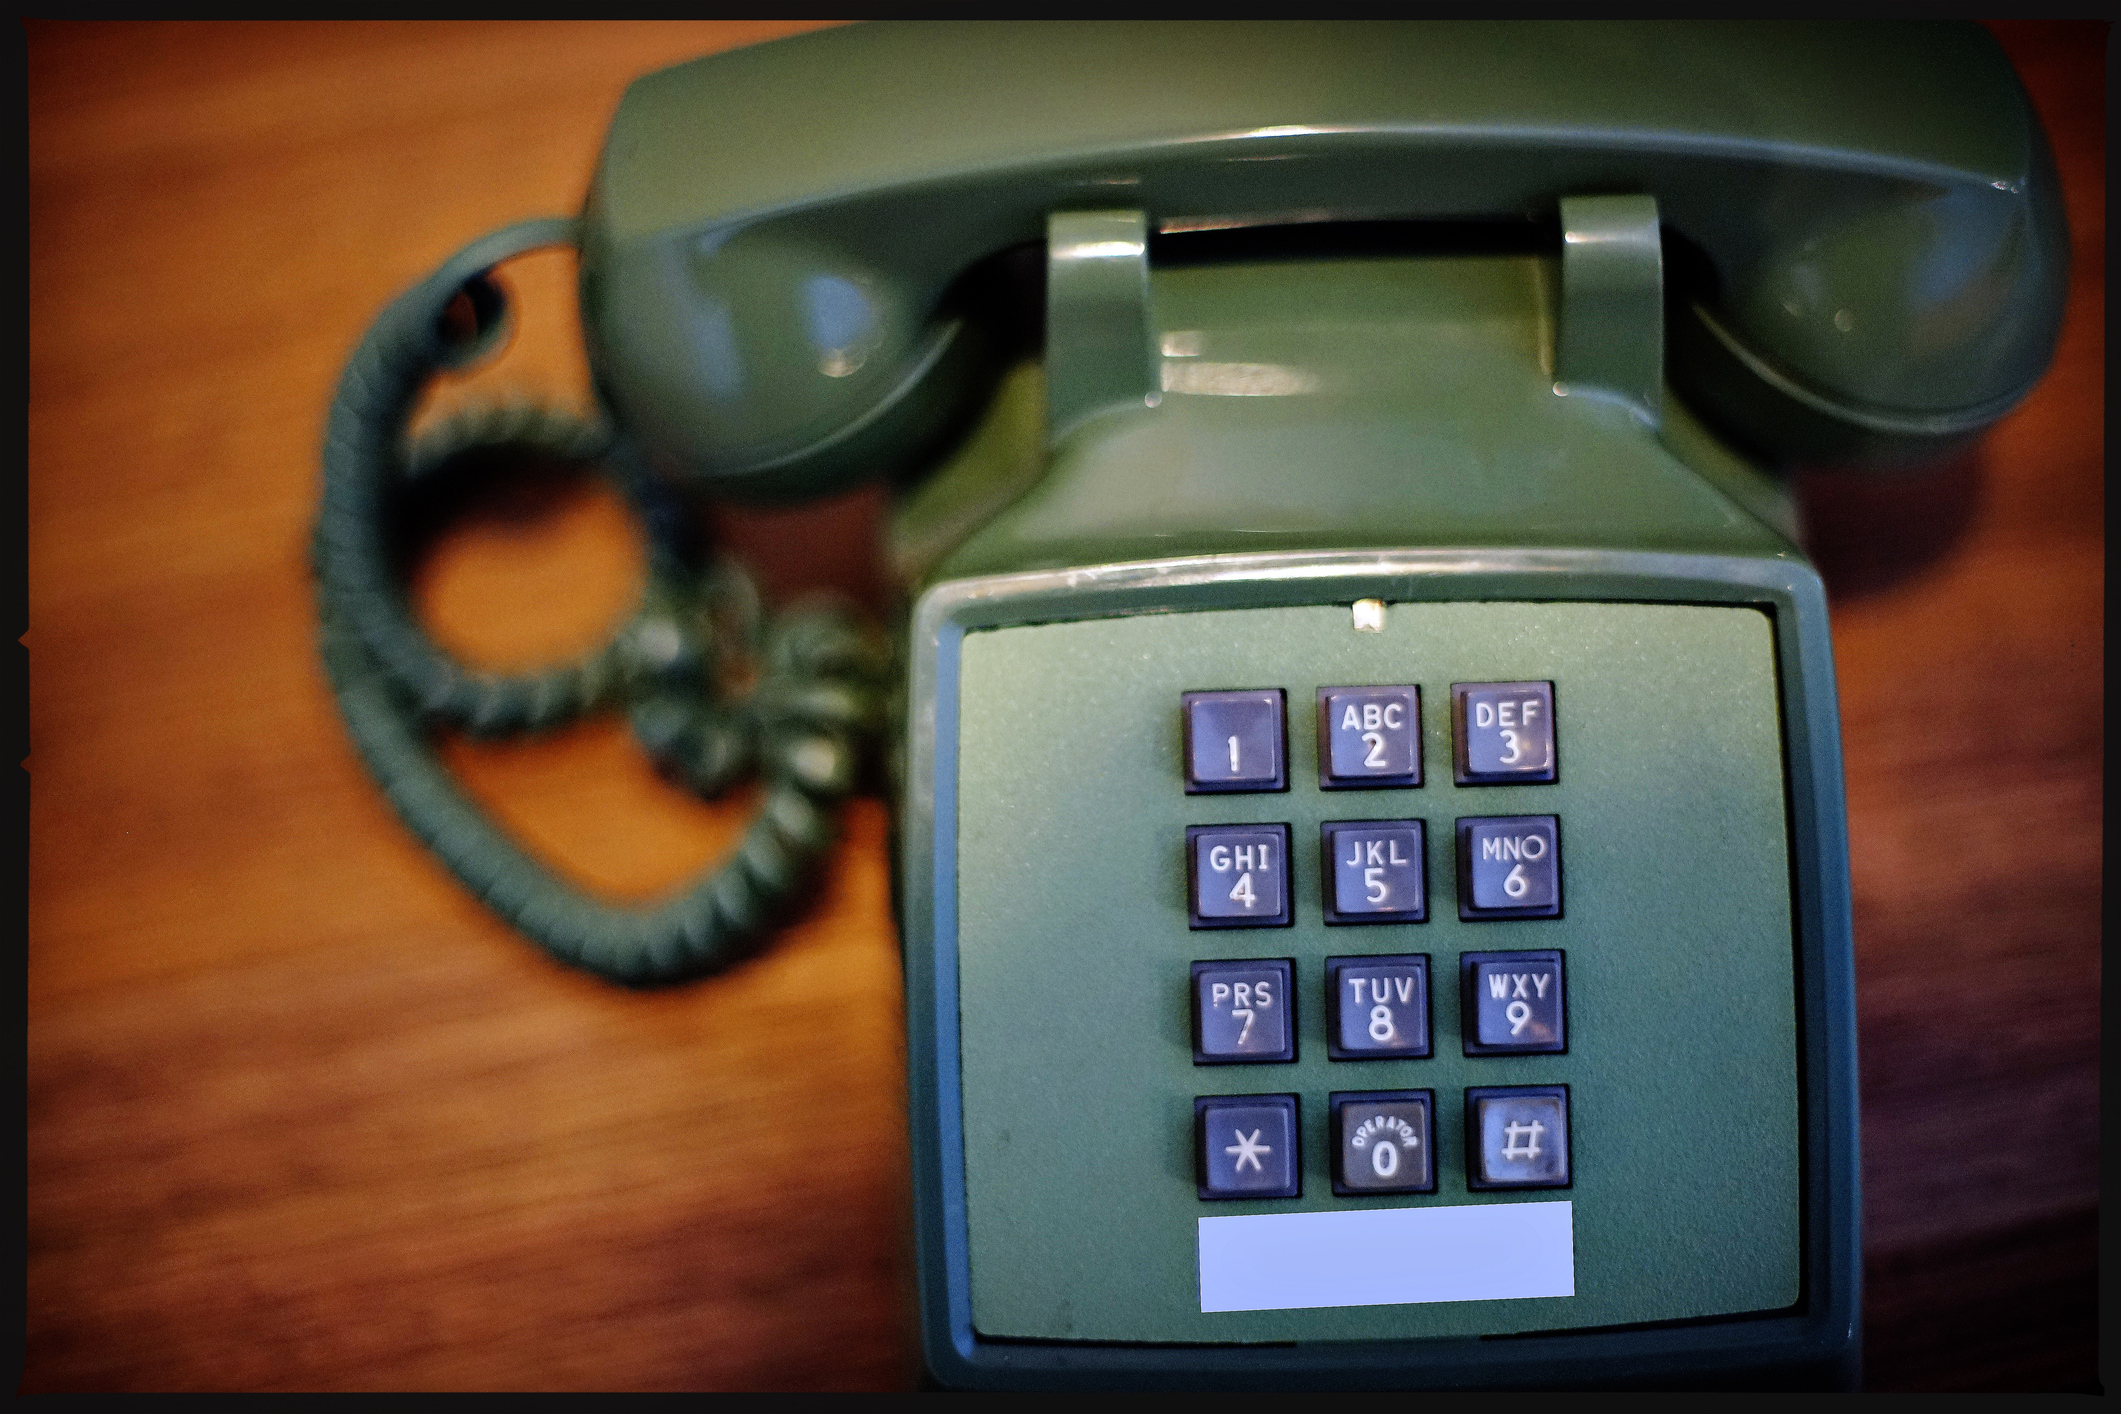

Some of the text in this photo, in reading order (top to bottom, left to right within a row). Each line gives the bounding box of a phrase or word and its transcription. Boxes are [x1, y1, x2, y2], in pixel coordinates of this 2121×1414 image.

[1342, 704, 1401, 730] ABC
[1476, 702, 1540, 727] DEF
[1227, 736, 1239, 771] 1
[1362, 733, 1386, 767] 2
[1500, 730, 1519, 763] 3
[1210, 845, 1268, 870] GHI
[1347, 841, 1406, 867] JKL
[1483, 836, 1544, 860] MNO
[1230, 873, 1255, 907] 4
[1365, 868, 1386, 902] 5
[1504, 864, 1525, 897] 6
[1213, 982, 1271, 1006] PRS
[1349, 978, 1412, 1003] TUV
[1489, 974, 1548, 998] WXY
[1232, 1009, 1254, 1044] 7
[1369, 1006, 1393, 1040] 8
[1506, 1002, 1530, 1035] 9
[1352, 1116, 1417, 1147] OPERATOR
[1372, 1141, 1397, 1176] 0
